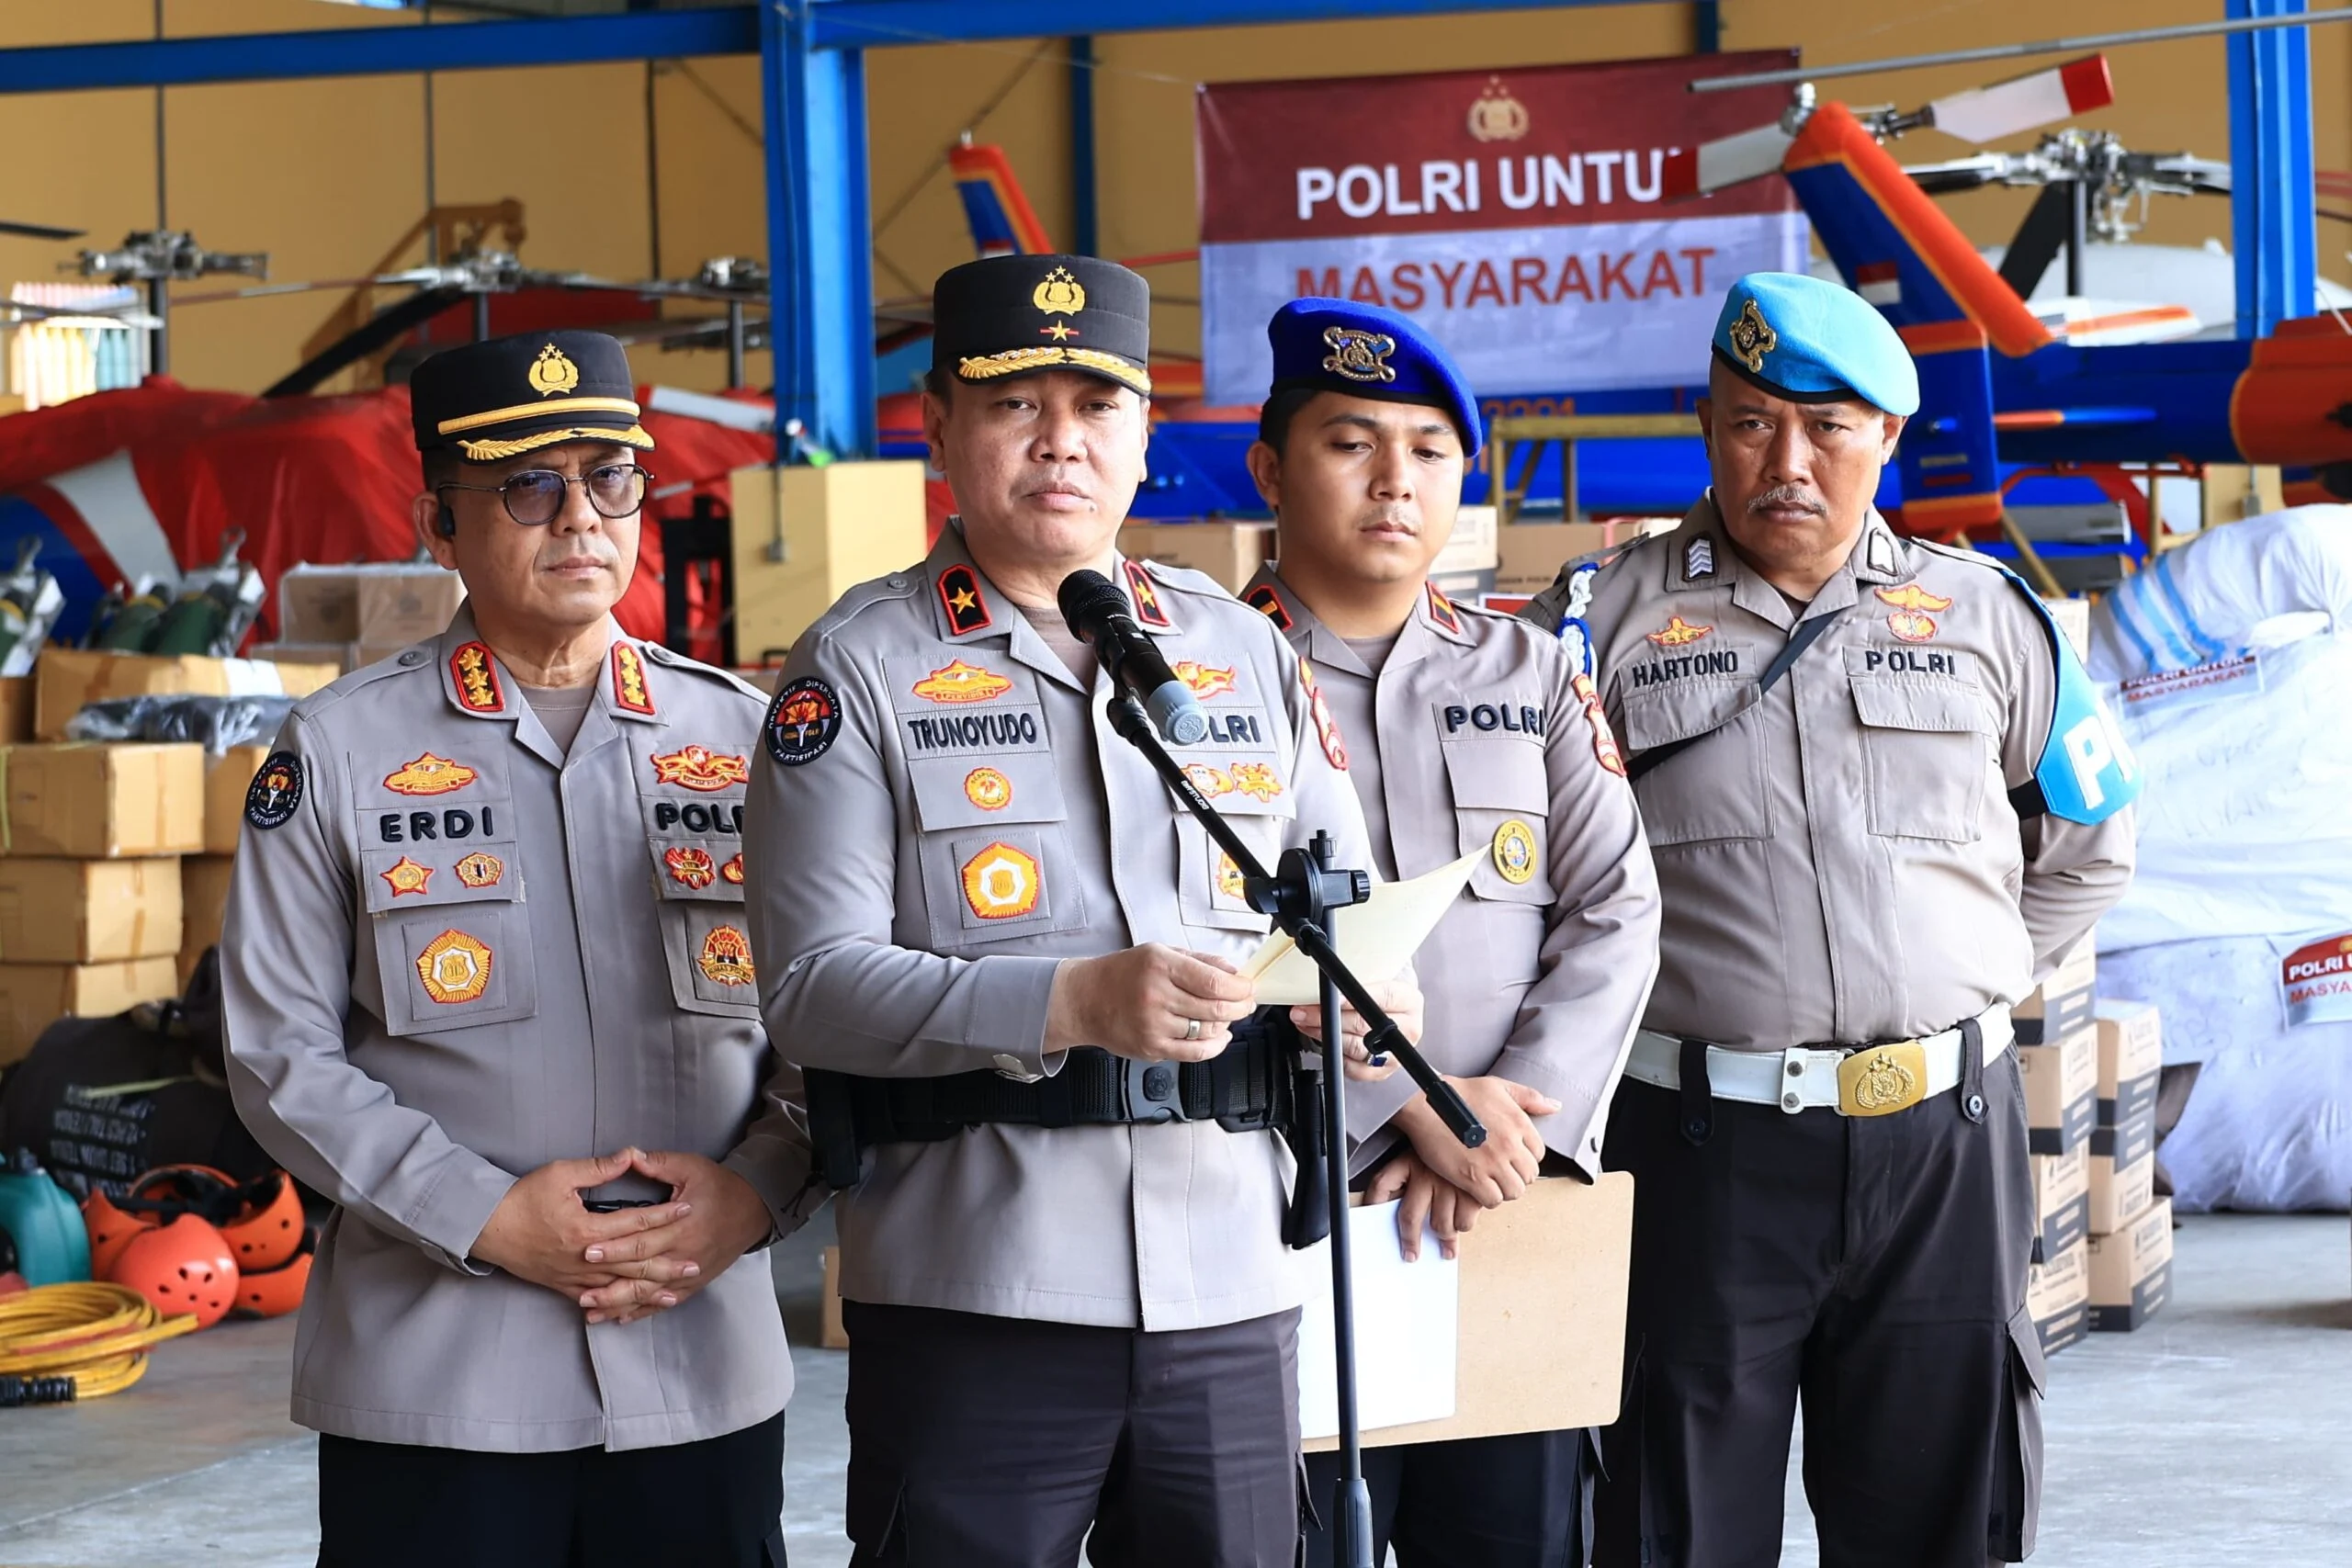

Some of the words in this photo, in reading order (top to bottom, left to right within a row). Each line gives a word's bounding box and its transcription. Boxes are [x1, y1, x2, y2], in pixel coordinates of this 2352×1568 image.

[1296, 161, 1481, 220] POLRI
[1499, 147, 1713, 210] UNTU
[1296, 248, 1716, 312] MASYARAKAT
[1633, 650, 1738, 687] HARTONO
[1865, 650, 1956, 675] POLRI
[908, 712, 1037, 750] TRUNOYUDO
[1444, 703, 1545, 738] POLRI
[380, 806, 494, 842] ERDI
[2289, 955, 2344, 981] POLRI
